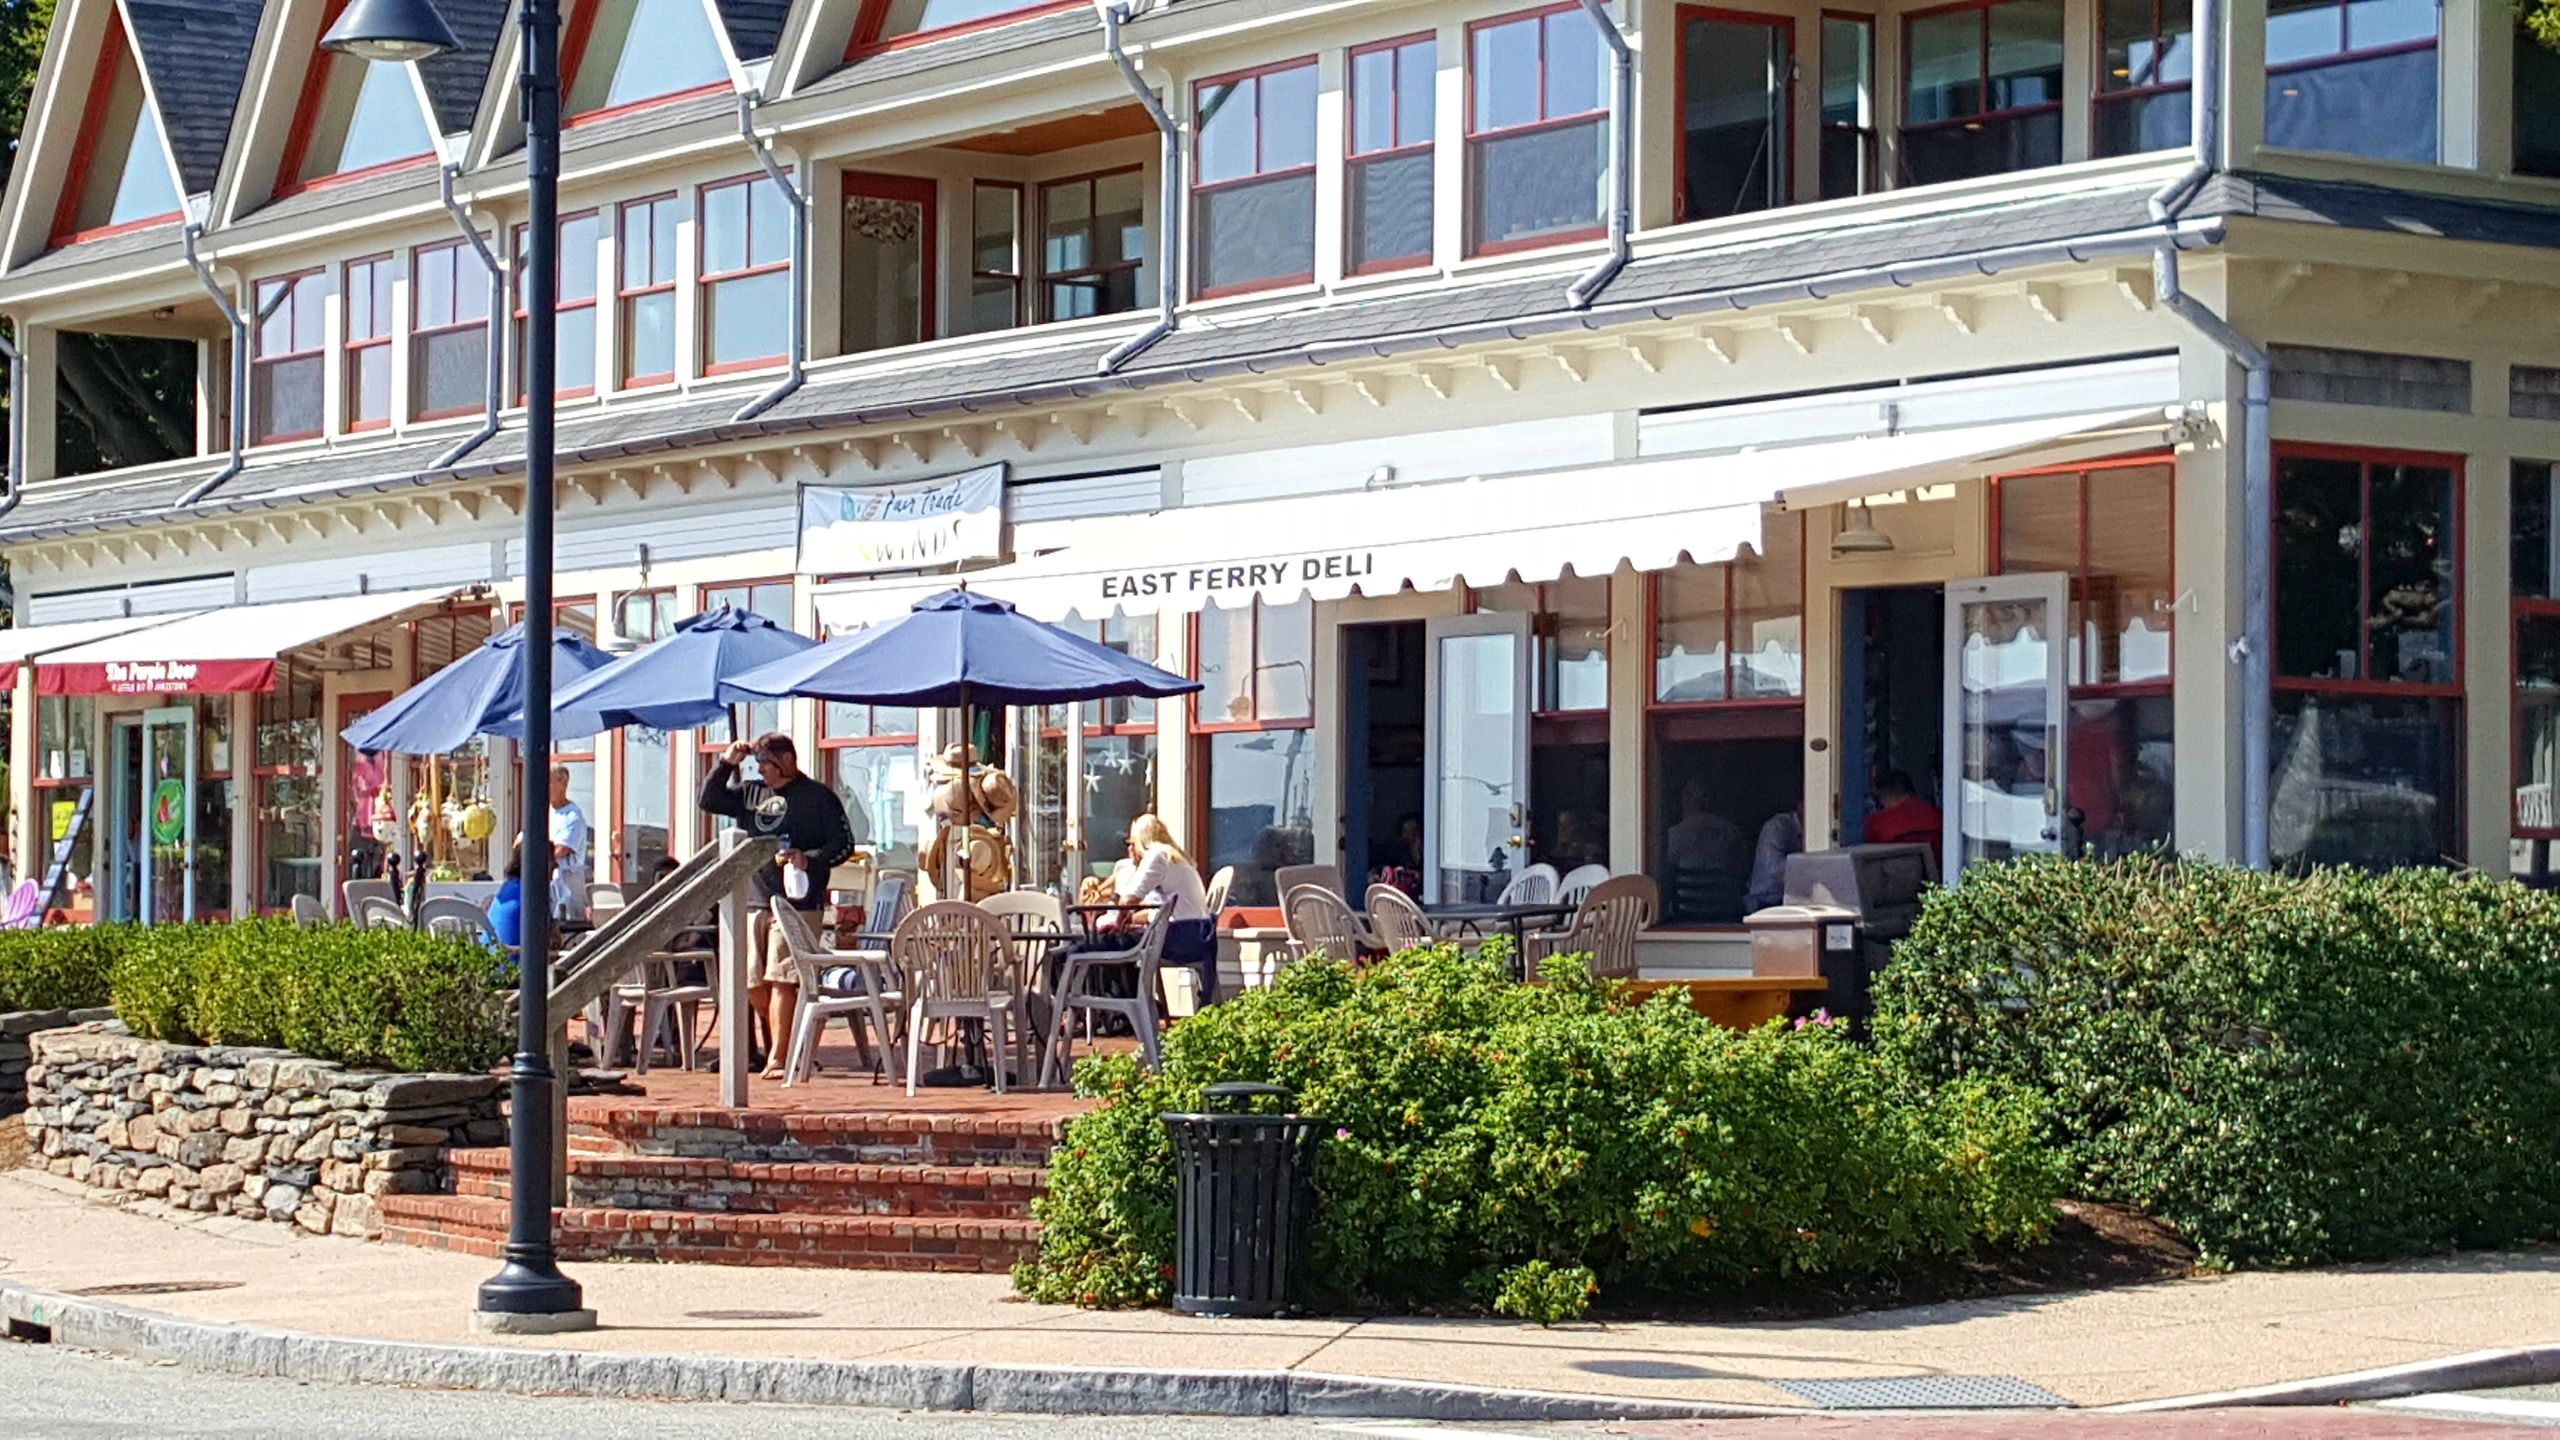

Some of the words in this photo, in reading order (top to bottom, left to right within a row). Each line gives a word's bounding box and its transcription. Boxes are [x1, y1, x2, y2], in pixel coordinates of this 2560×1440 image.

[882, 489, 916, 520] Fair
[921, 479, 965, 515] Trade
[1102, 572, 1177, 599] EAST
[1189, 562, 1288, 591] FERRY
[1302, 553, 1372, 581] DELI
[105, 662, 128, 682] The
[128, 661, 167, 687] Purple
[166, 661, 198, 680] Door
